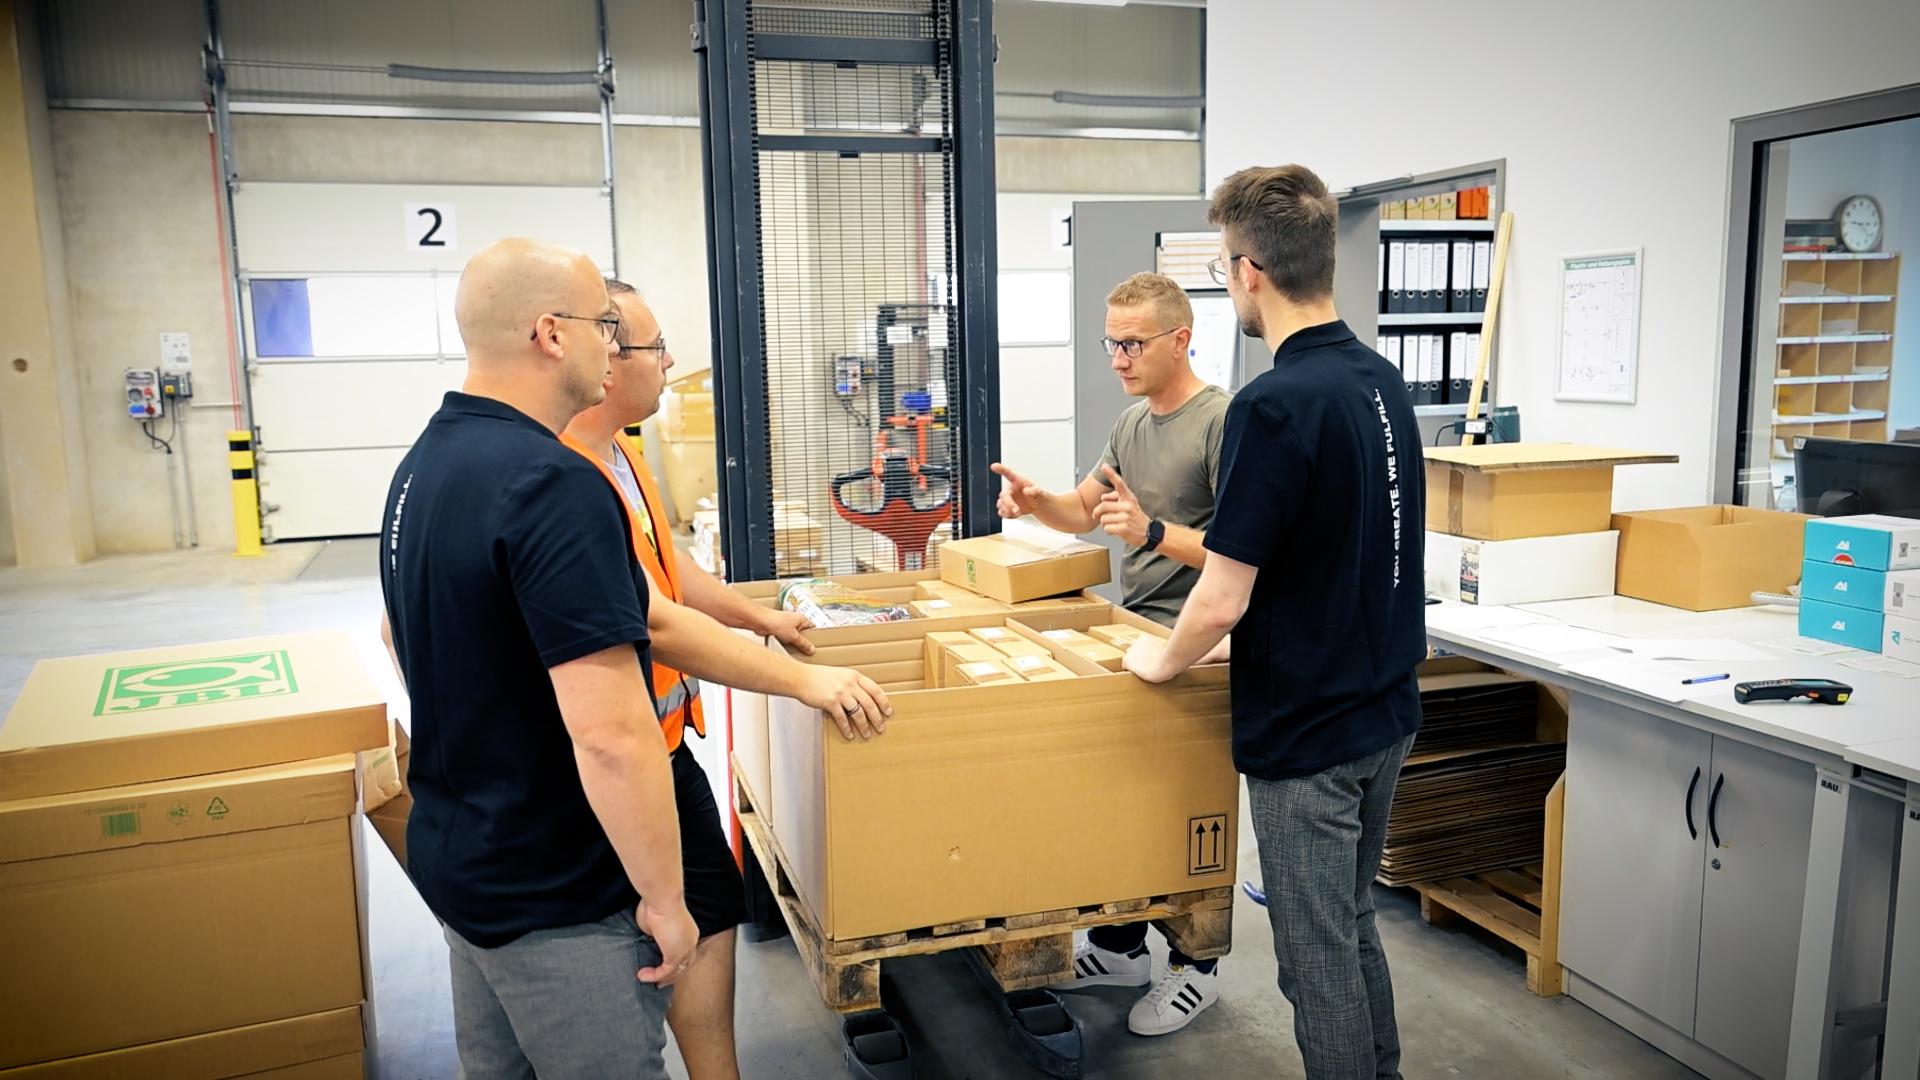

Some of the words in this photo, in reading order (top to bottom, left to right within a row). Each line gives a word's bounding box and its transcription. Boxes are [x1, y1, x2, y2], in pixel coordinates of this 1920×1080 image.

[417, 208, 446, 246] 2
[1374, 388, 1395, 453] FULFILL.
[1387, 455, 1398, 482] WE
[109, 684, 286, 711] JBL
